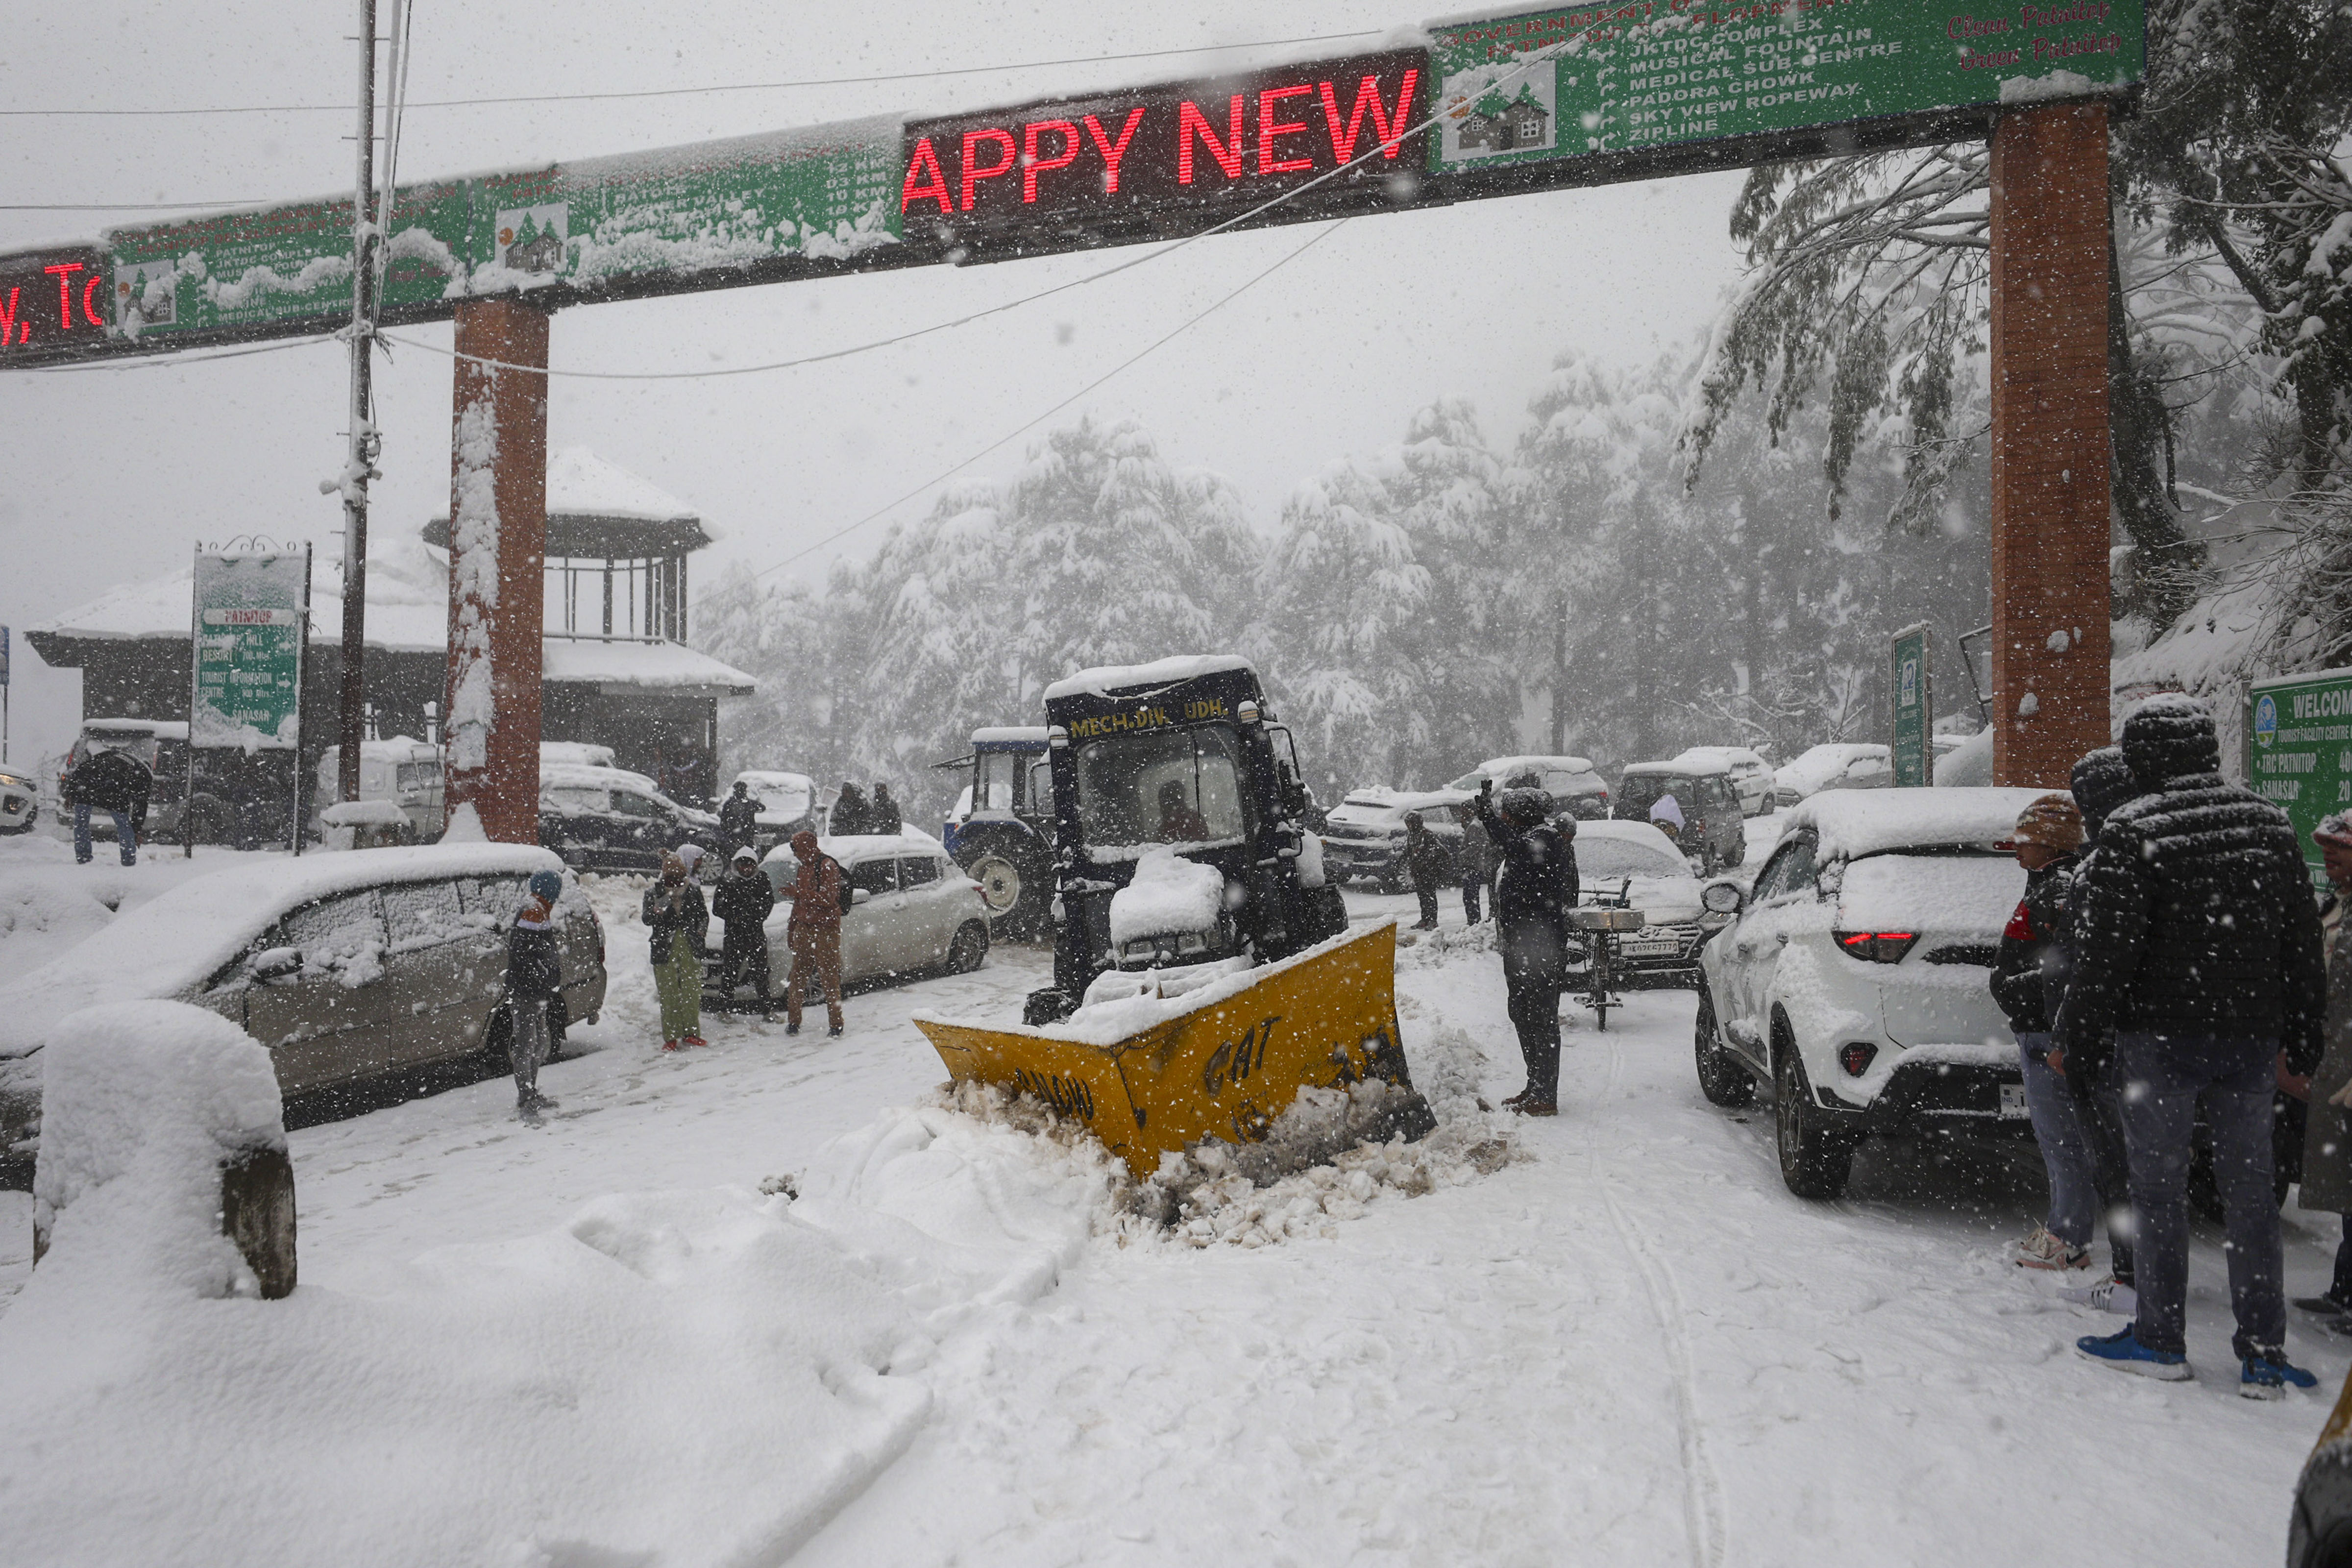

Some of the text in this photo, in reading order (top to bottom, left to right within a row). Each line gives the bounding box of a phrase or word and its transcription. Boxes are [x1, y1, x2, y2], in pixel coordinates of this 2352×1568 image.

[1443, 2, 1658, 47] GOVERNMENT
[1947, 0, 2110, 39] Clean Patnitop
[1630, 18, 1822, 57] JKTDC COMPLEX
[1630, 28, 1872, 74] MUSICAL FOUNTAIN
[1960, 32, 2121, 71] Green Patnitop
[1630, 41, 1902, 91] MEDICAL SUB-CENTRE
[1630, 72, 1814, 108] PADORA CHOWK
[1629, 82, 1860, 125] SKY VIEW ROPEWAY
[902, 69, 1418, 213] APPY NEW
[1629, 119, 1718, 141] ZIPLINE
[855, 156, 886, 170] KM
[857, 172, 887, 185] KM
[855, 186, 886, 199] KM
[329, 200, 357, 213] AN
[138, 236, 209, 254] PATNITOP
[214, 219, 328, 245] DEVELOPMENT
[216, 243, 275, 257] PATNITOP
[216, 246, 321, 268] JKTDC COMPLEX
[219, 308, 271, 322] MEDICAL
[202, 671, 272, 685] TOURIST INFORMATION
[201, 686, 224, 698] CENTRE
[232, 710, 270, 722] SANASAR
[2278, 728, 2301, 743] TOURIST
[2301, 726, 2325, 741] FACILITY
[2325, 725, 2349, 740] CENTRE
[2262, 751, 2352, 773] TRC PATNITOP 40
[2262, 780, 2351, 801] SANASAR 20
[1205, 1015, 1282, 1099] CAT
